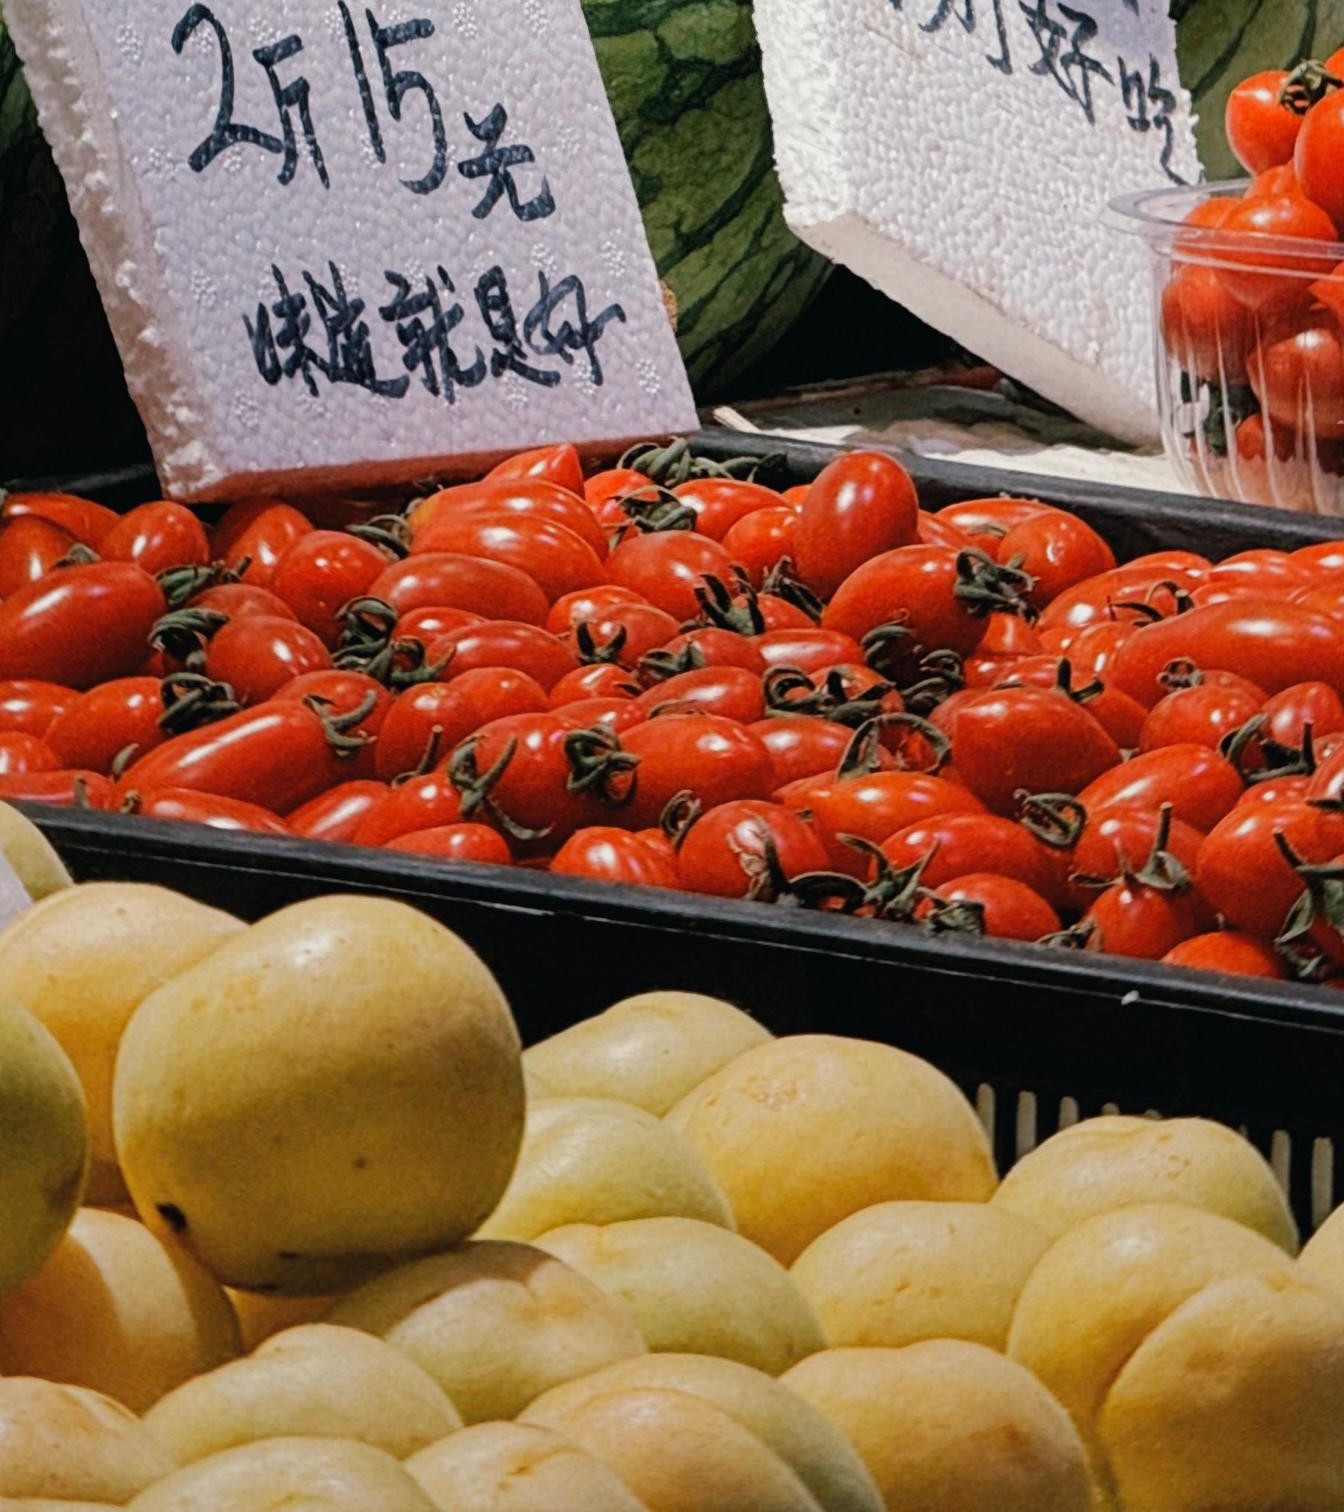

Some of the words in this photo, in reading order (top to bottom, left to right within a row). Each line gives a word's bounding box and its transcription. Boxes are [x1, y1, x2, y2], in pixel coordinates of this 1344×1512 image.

[171, 0, 556, 221] 2斤15元
[243, 260, 626, 405] 味道就是好
